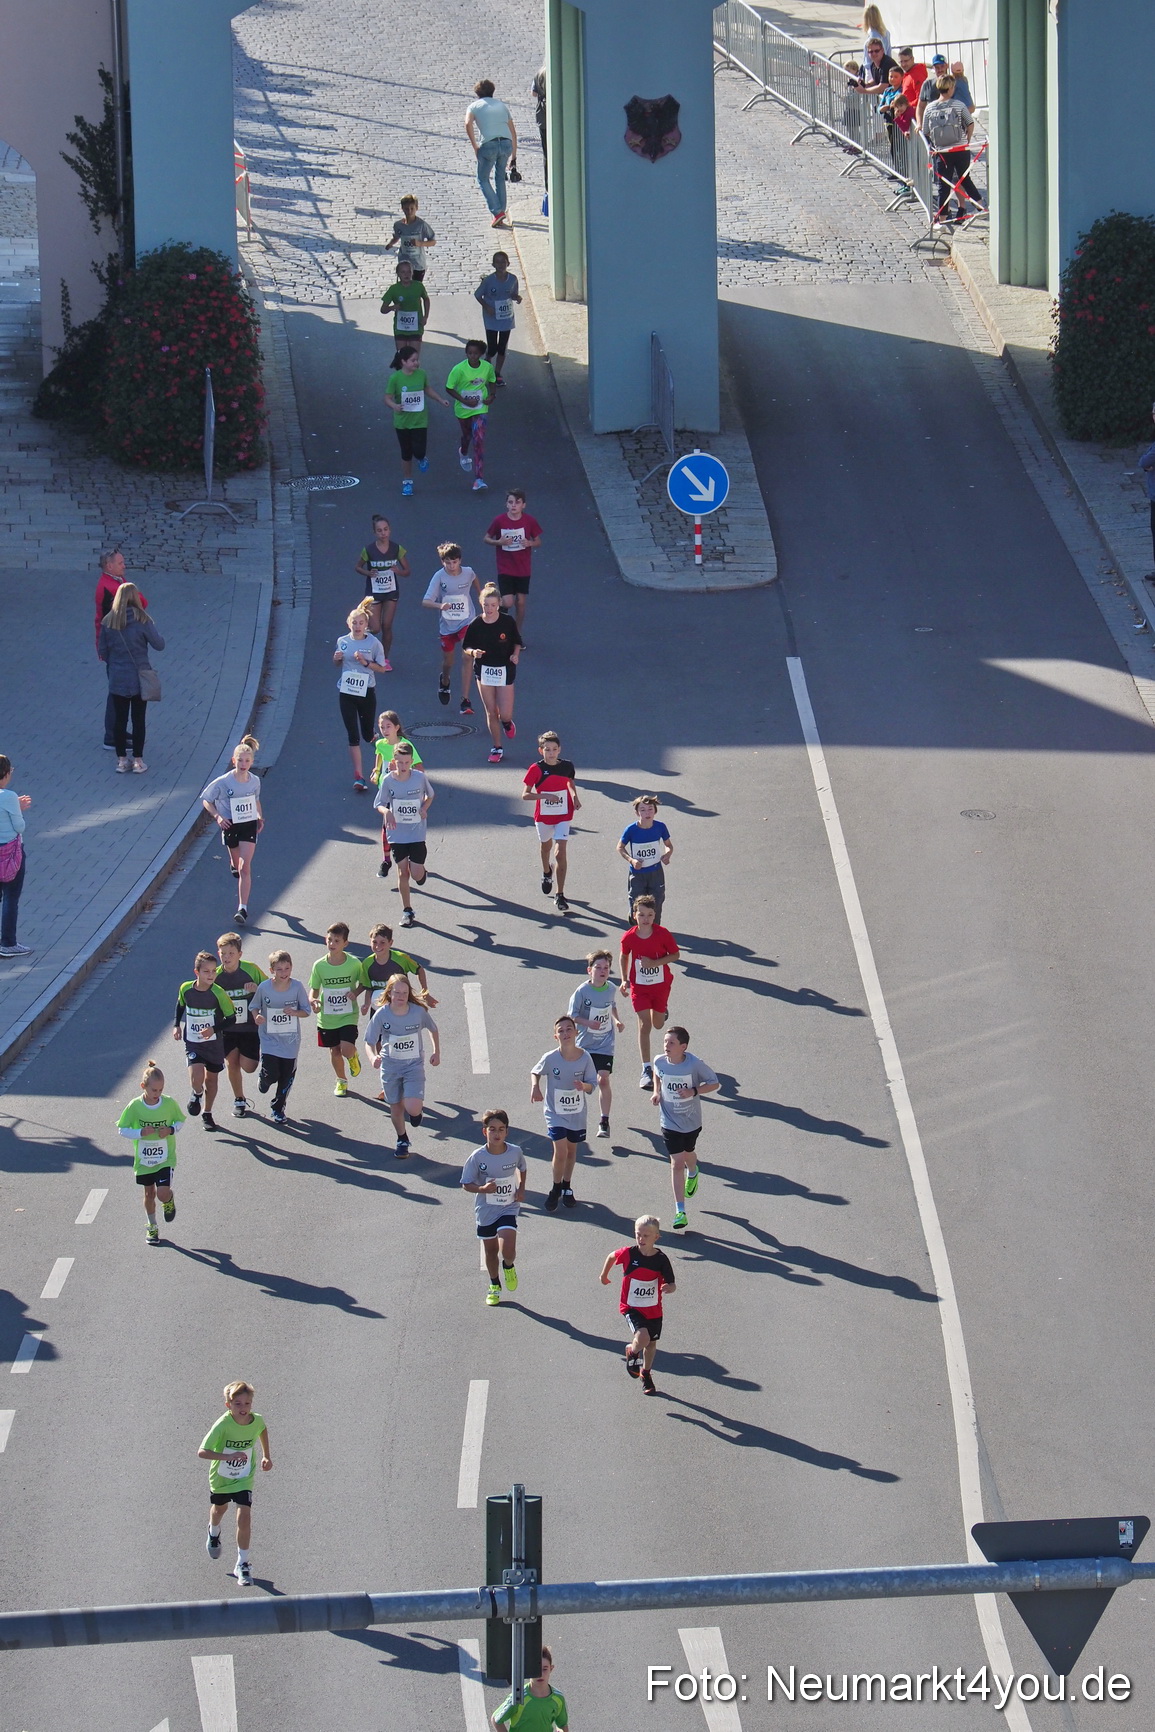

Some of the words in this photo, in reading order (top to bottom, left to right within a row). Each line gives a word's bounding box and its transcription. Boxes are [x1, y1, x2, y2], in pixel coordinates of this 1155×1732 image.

[485, 668, 502, 676] 4049
[346, 677, 364, 687] 4010
[235, 803, 252, 813] 4011
[398, 806, 417, 814] 4036
[637, 849, 656, 858] 4039
[640, 966, 659, 974] 4000
[324, 977, 351, 985] BOCK
[327, 995, 347, 1004] 4028
[234, 1006, 243, 1014] 29
[272, 1015, 291, 1023] 4051
[393, 1041, 414, 1050] 4052
[560, 1095, 580, 1104] 4014
[142, 1147, 163, 1156] 4025
[494, 1184, 512, 1194] 002
[634, 1287, 655, 1296] 4043
